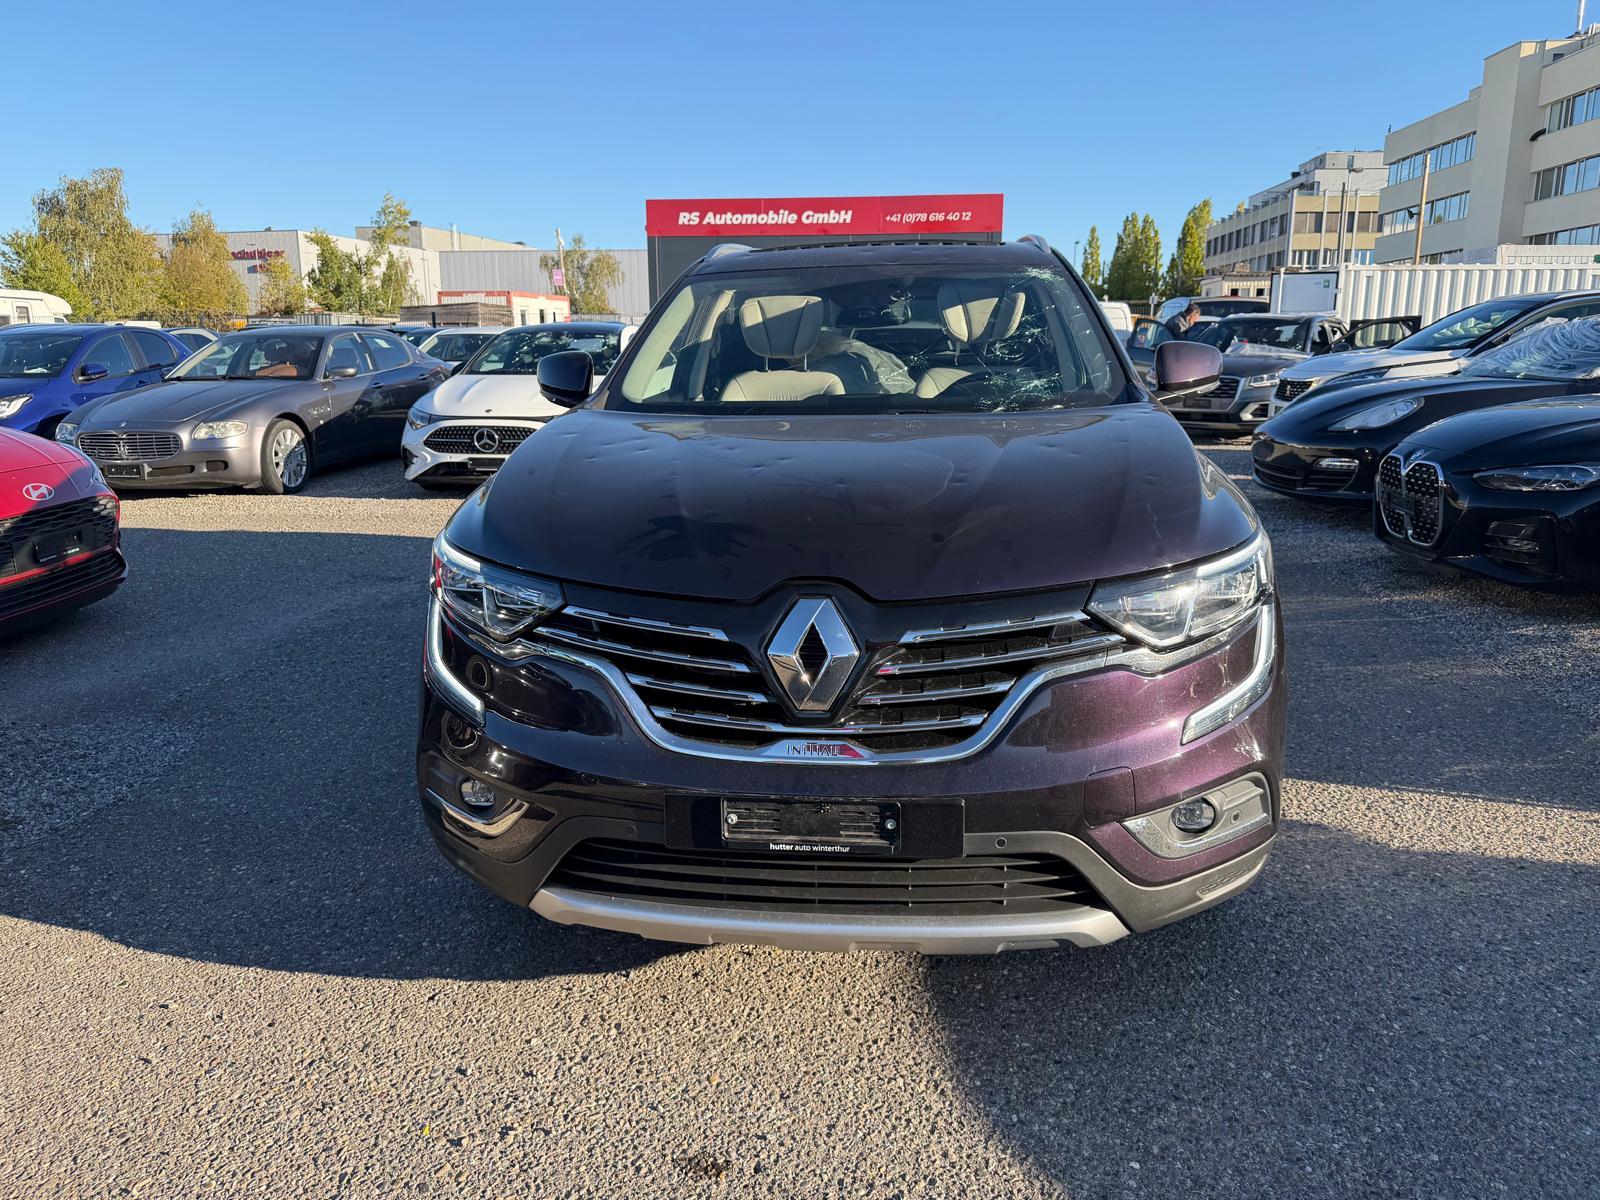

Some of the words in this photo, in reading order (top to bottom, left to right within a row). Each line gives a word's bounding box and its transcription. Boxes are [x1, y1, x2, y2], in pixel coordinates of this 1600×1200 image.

[678, 211, 700, 225] RS
[702, 209, 798, 225] Automobile
[801, 209, 853, 224] GmbH
[885, 213, 901, 222] +41
[903, 212, 928, 224] (0)78
[929, 212, 945, 222] 616
[946, 211, 960, 221] 40
[961, 211, 972, 221] 12
[770, 843, 793, 851] hutter
[795, 844, 810, 852] auto
[812, 844, 850, 854] winterthur
